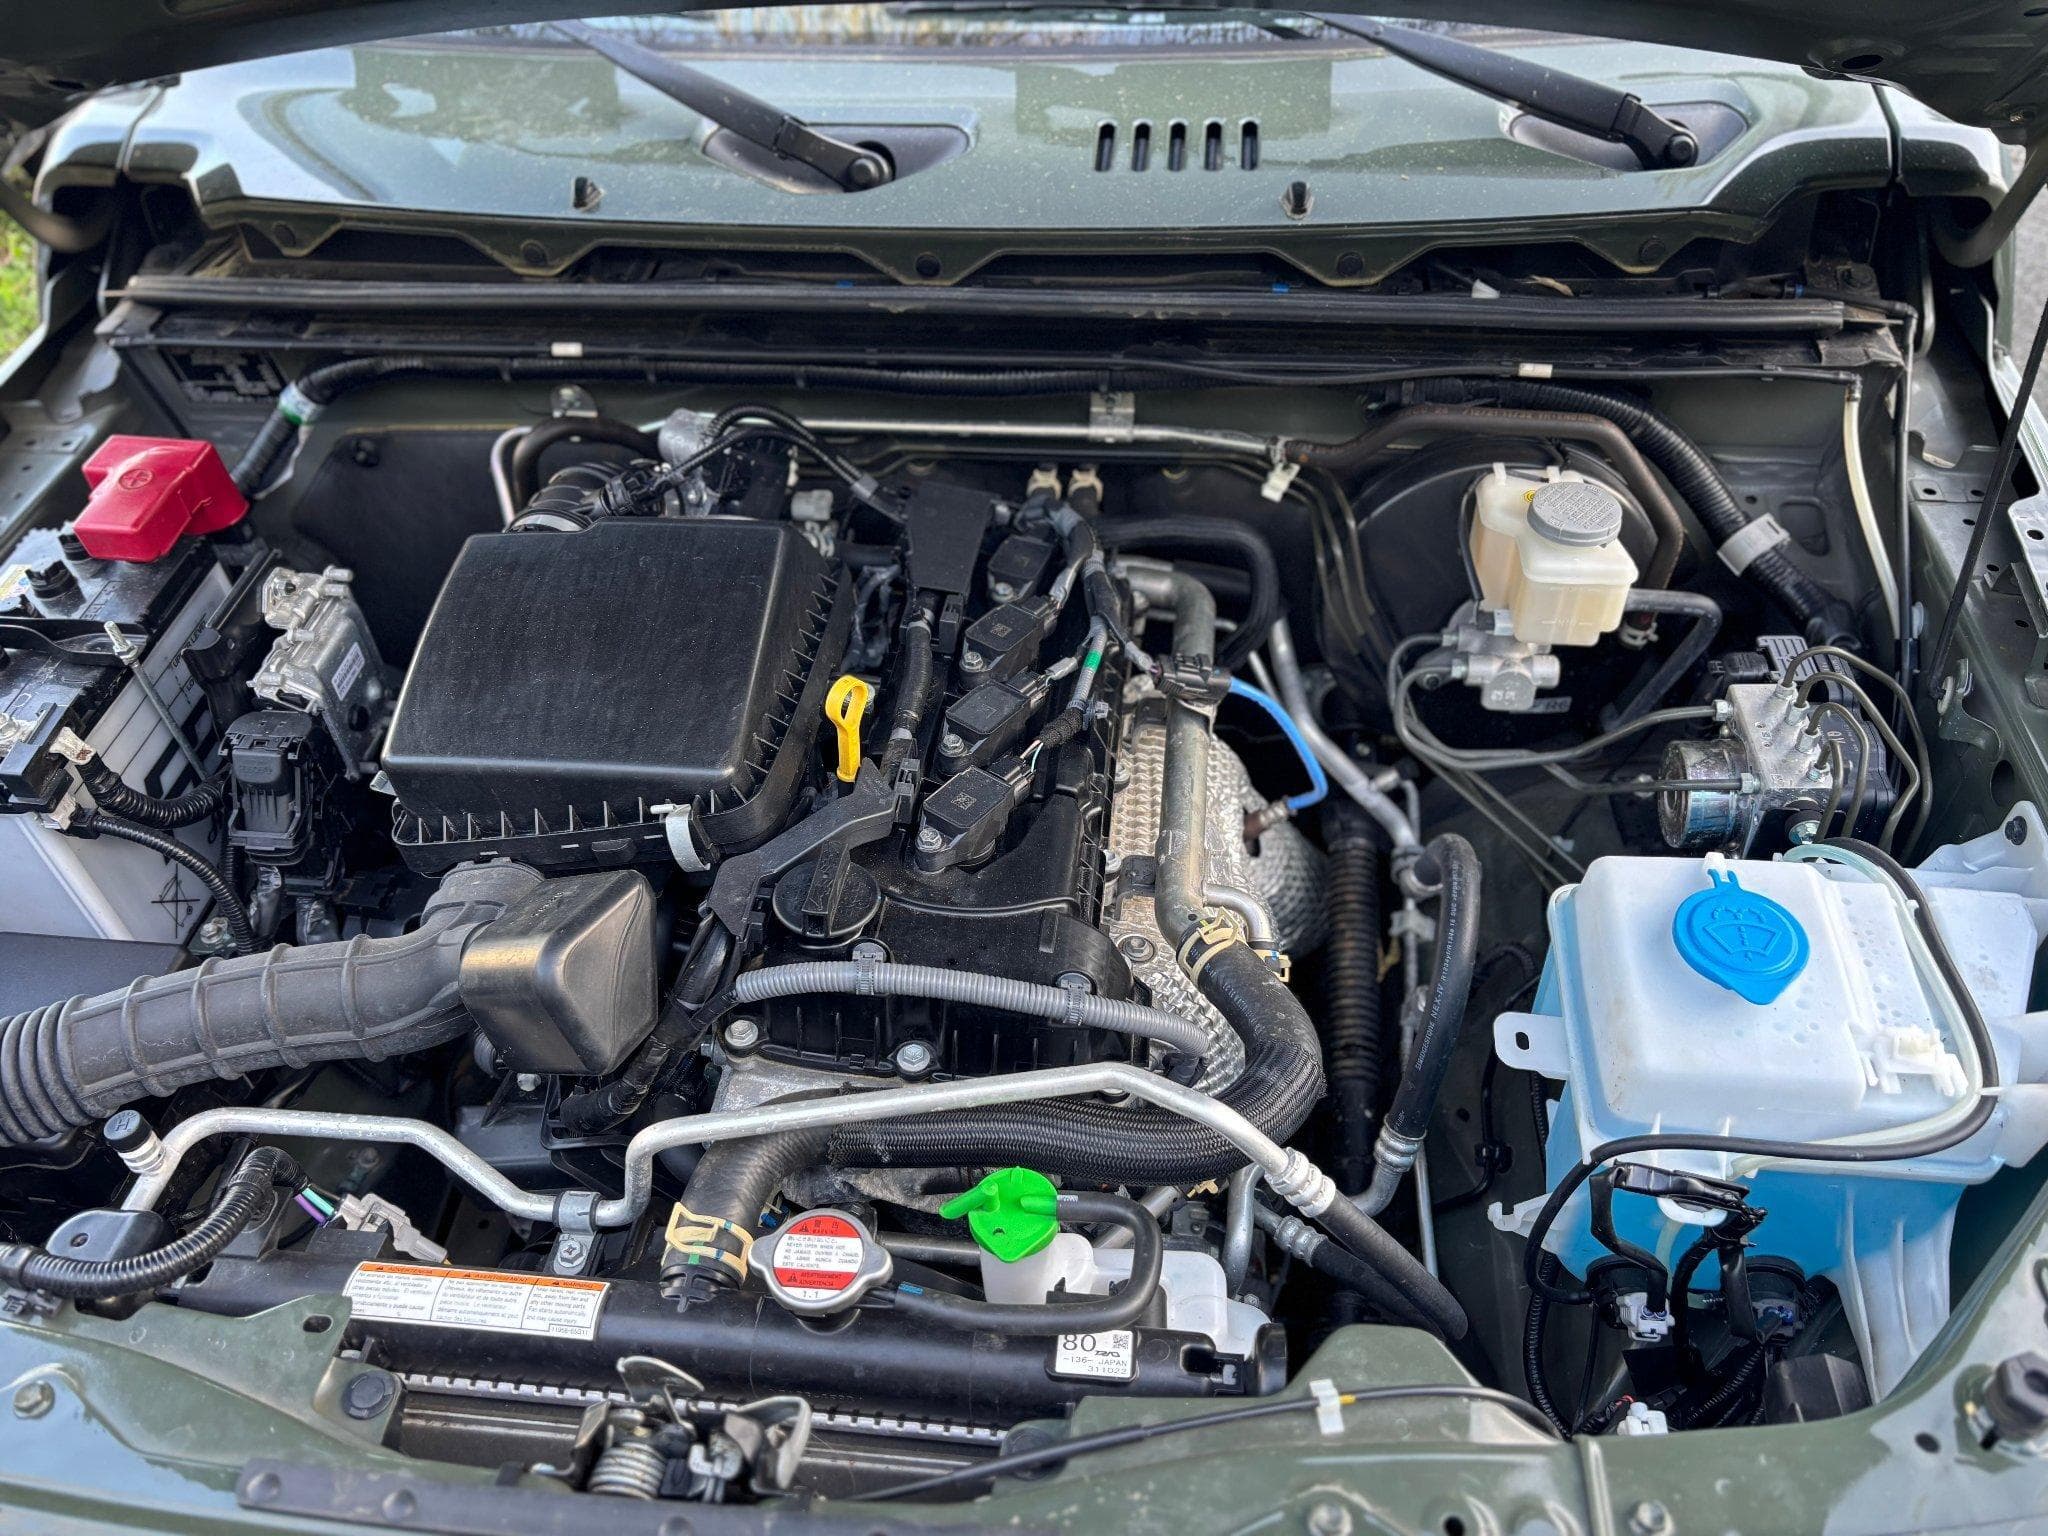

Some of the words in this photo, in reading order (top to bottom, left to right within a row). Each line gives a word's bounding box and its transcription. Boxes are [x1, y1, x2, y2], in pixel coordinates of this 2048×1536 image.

[803, 1290, 819, 1299] 1.1
[1062, 1334, 1097, 1352] 80
[1098, 1359, 1128, 1367] JAPAN
